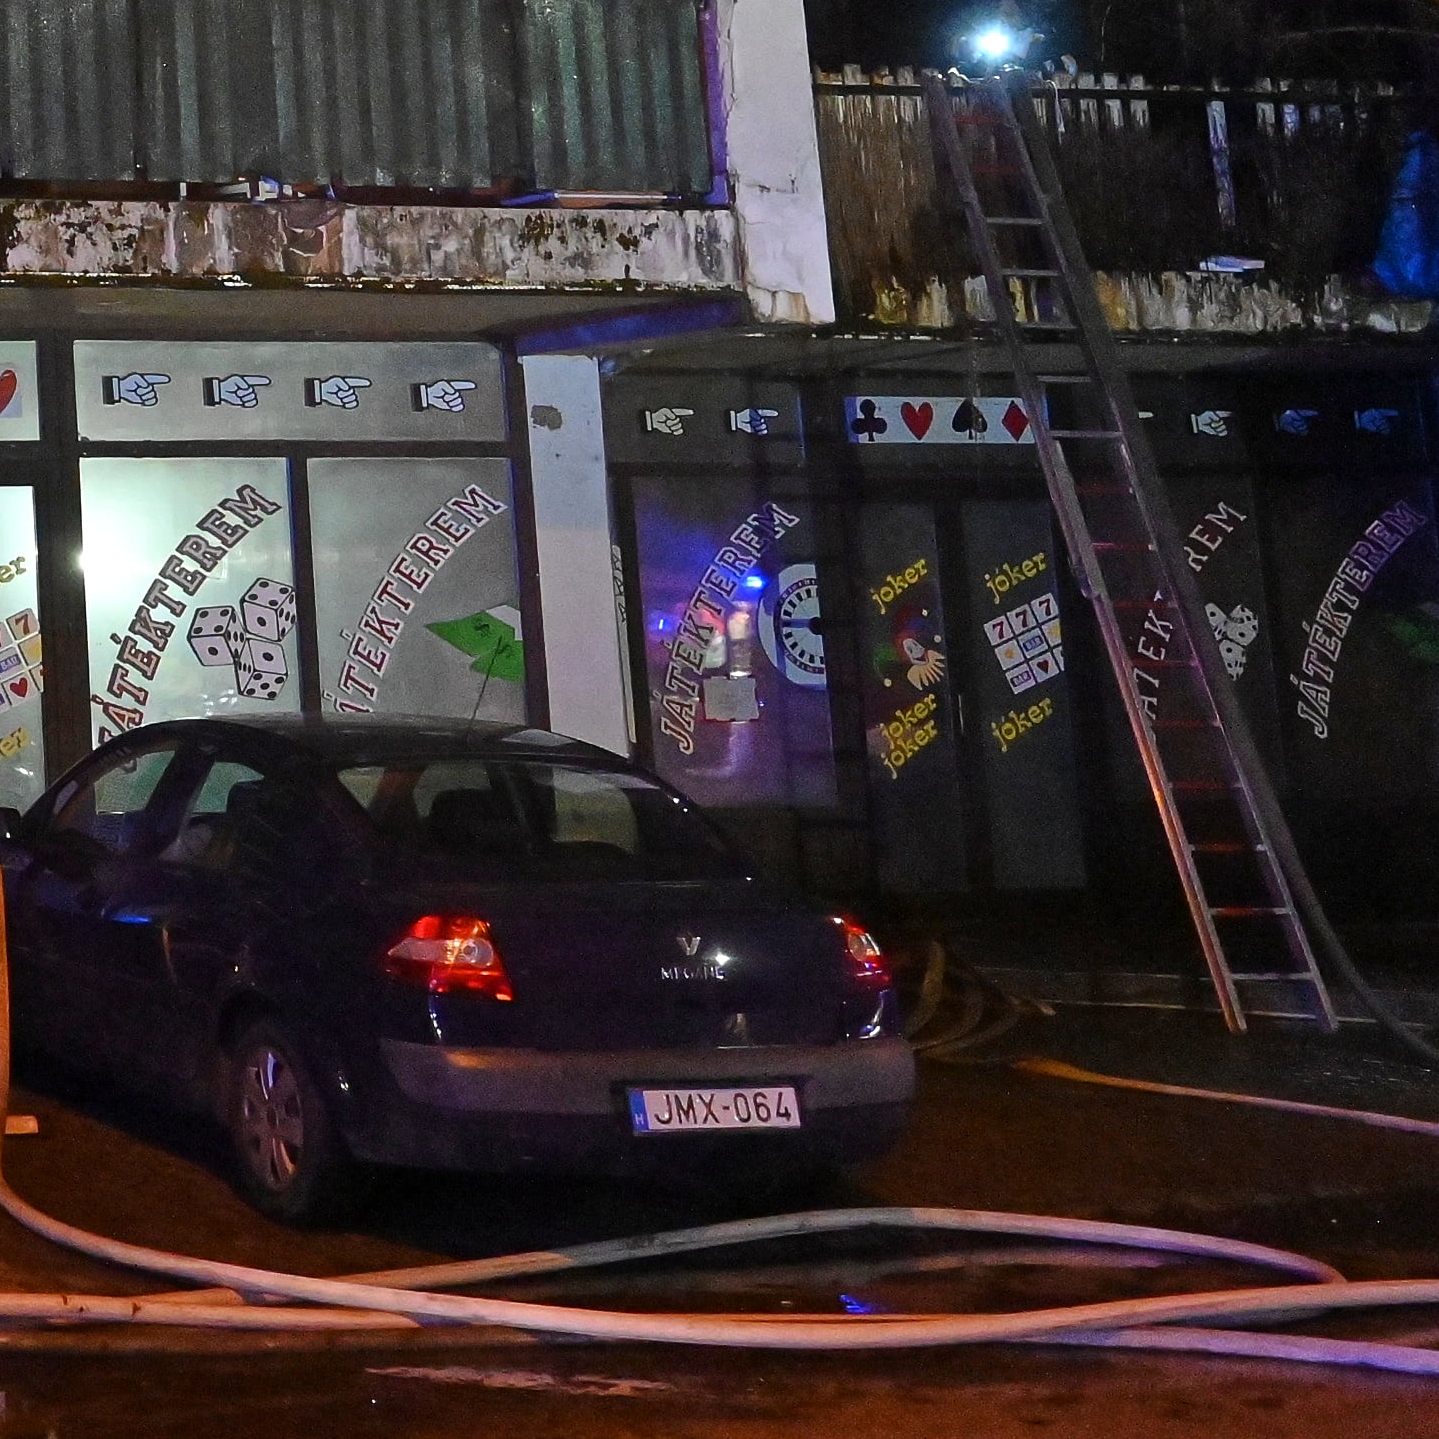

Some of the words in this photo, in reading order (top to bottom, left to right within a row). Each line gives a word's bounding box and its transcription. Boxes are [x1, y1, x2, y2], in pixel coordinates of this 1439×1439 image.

[15, 613, 30, 635] 7
[652, 501, 801, 755] JÁTÉKTEREM
[992, 621, 1005, 640] 7
[1015, 609, 1028, 628] 7
[1038, 598, 1051, 617] 7
[1290, 499, 1427, 739] JÁTÉKTEREM
[654, 1091, 792, 1126] JMX-064
